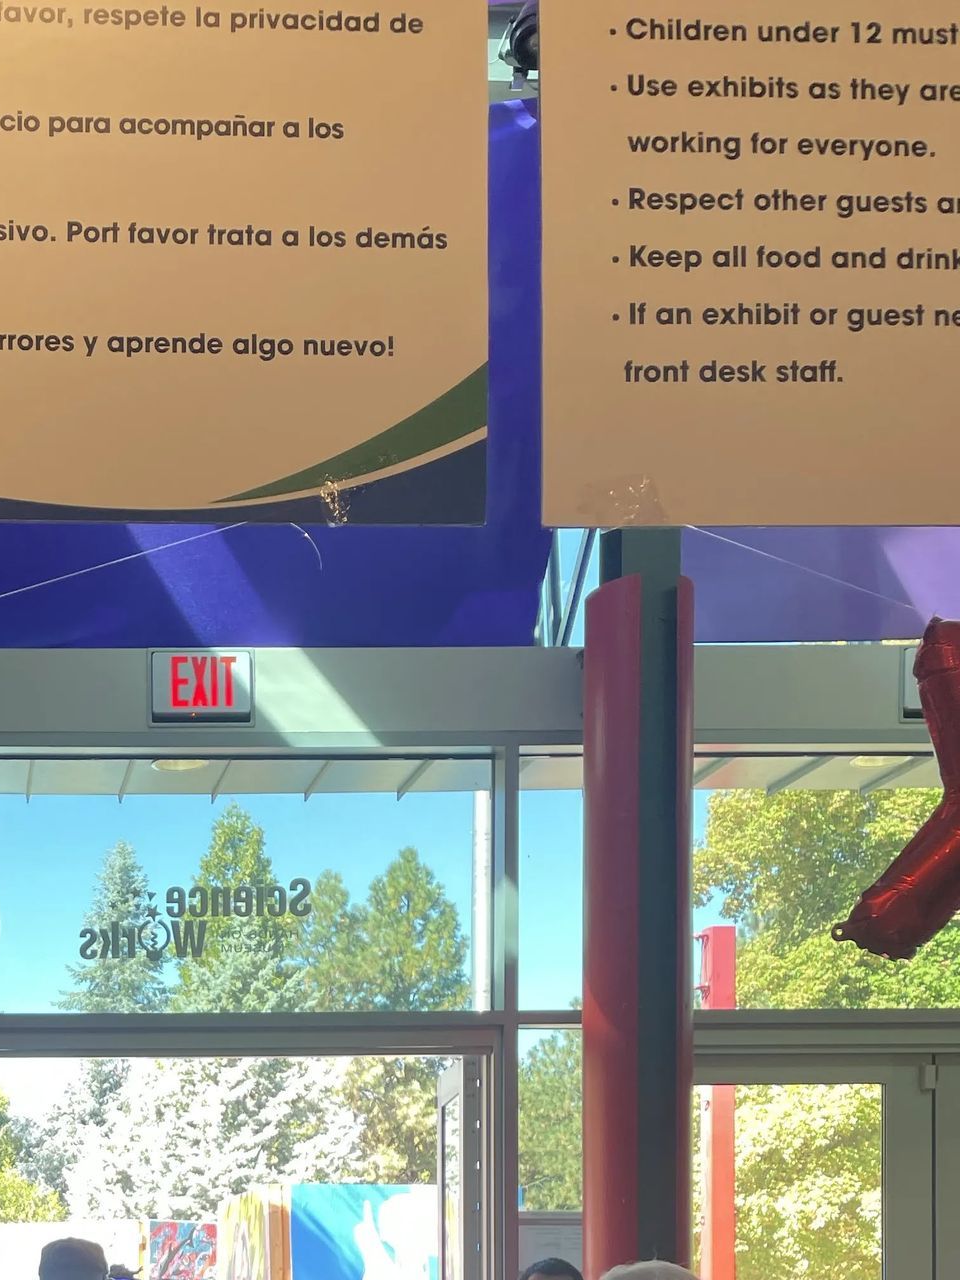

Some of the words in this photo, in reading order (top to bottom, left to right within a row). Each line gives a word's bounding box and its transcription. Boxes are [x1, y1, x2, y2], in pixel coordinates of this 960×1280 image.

[84, 5, 186, 31] respete
[195, 6, 220, 28] la
[230, 7, 380, 33] privacidad
[389, 12, 424, 35] de
[625, 17, 747, 42] Children
[757, 20, 840, 44] under
[850, 21, 882, 44] 12
[892, 22, 959, 45] must
[627, 73, 678, 97] Use
[687, 75, 799, 100] exhibits
[808, 82, 841, 100] as
[849, 77, 911, 106] they
[919, 83, 960, 102] are
[48, 115, 111, 138] para
[119, 114, 276, 141] acompañar
[282, 121, 300, 139] a
[308, 117, 344, 140] los
[627, 130, 741, 161] working
[750, 131, 789, 155] for
[797, 137, 936, 162] everyone.
[628, 187, 745, 216] Respect
[753, 188, 828, 212] other
[835, 191, 928, 219] guests
[66, 220, 121, 244] Port
[127, 221, 199, 245] favor
[206, 223, 272, 247] trata
[281, 230, 299, 247] a
[309, 225, 347, 248] los
[355, 225, 448, 250] demás
[629, 244, 703, 273] Keep
[712, 245, 747, 268] all
[756, 245, 821, 269] food
[831, 246, 886, 270] and
[629, 302, 647, 325] If
[655, 307, 692, 326] an
[702, 302, 801, 326] exhibit
[809, 307, 839, 326] or
[846, 303, 926, 333] guest
[82, 335, 99, 358] y
[106, 332, 224, 358] aprende
[232, 333, 294, 362] algo
[303, 335, 394, 357] nuevo!
[623, 359, 690, 383] front
[698, 359, 767, 383] desk
[776, 359, 844, 383] staff.
[171, 656, 237, 707] EXIT
